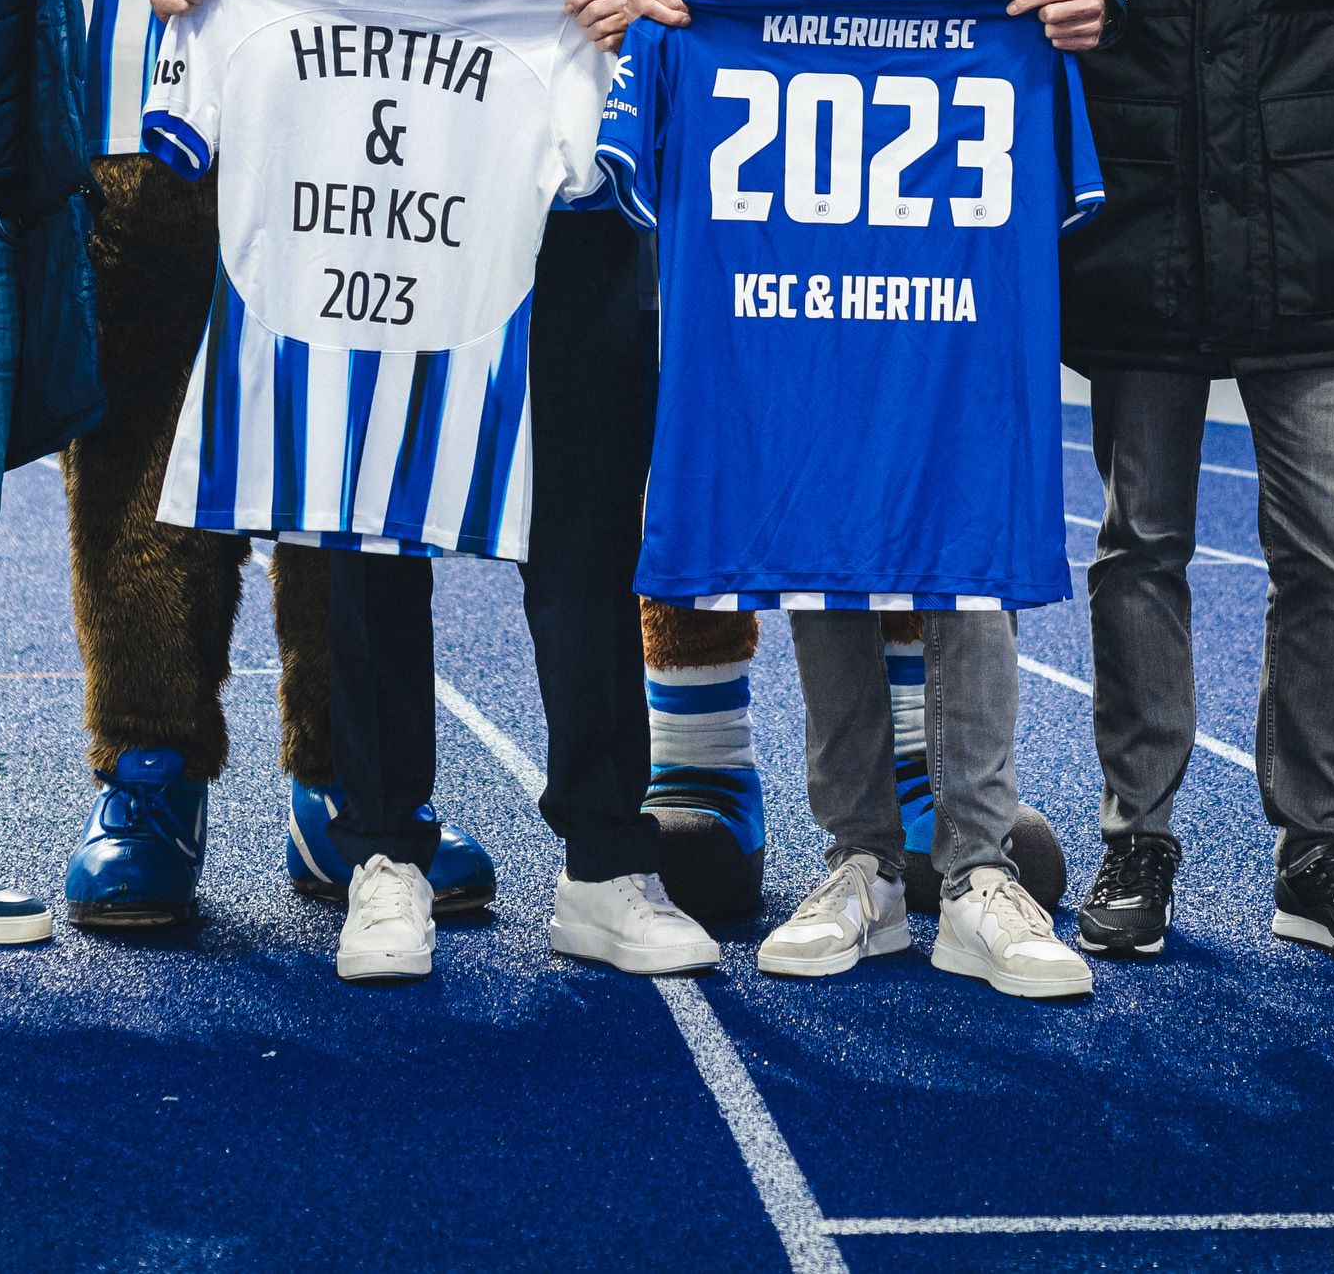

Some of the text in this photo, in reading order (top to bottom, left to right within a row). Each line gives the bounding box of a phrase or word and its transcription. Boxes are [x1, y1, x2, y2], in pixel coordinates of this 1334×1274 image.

[290, 25, 494, 103] HERTHA
[762, 15, 977, 49] KARLSRUHER SC
[365, 98, 407, 167] &
[709, 67, 1015, 228] 2023
[292, 181, 465, 248] DER KSC
[319, 268, 417, 326] 2023
[734, 273, 977, 322] KSC & HERTHA
